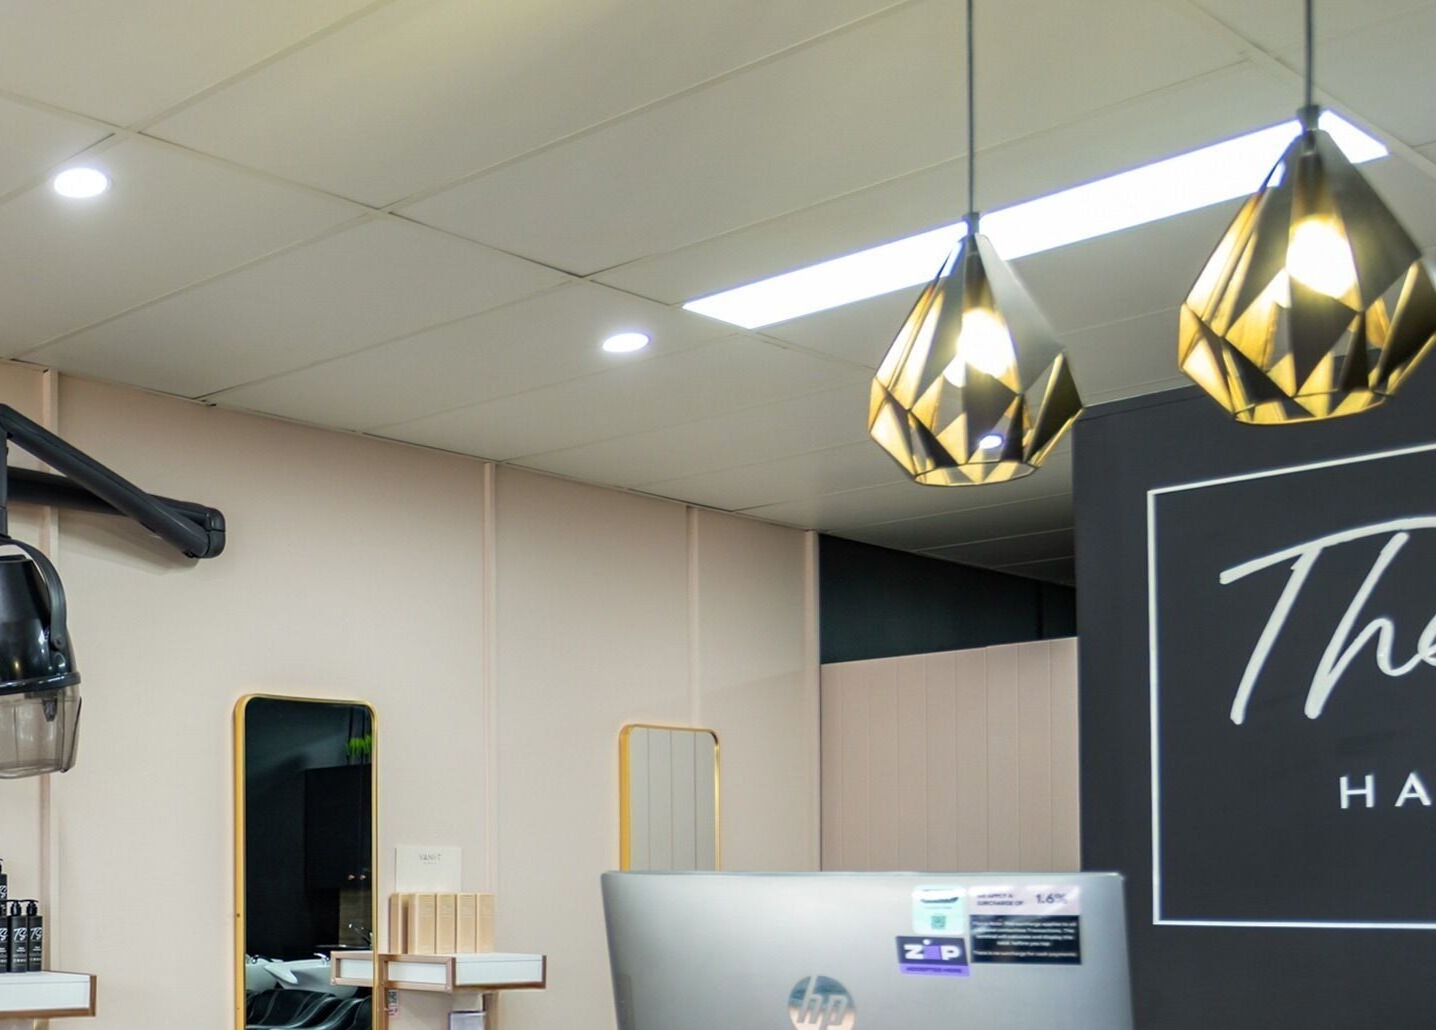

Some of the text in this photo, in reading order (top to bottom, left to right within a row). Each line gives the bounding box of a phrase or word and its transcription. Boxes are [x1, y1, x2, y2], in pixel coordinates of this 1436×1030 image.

[1220, 516, 1436, 726] Th
[1339, 772, 1432, 810] HA
[904, 939, 961, 961] zip
